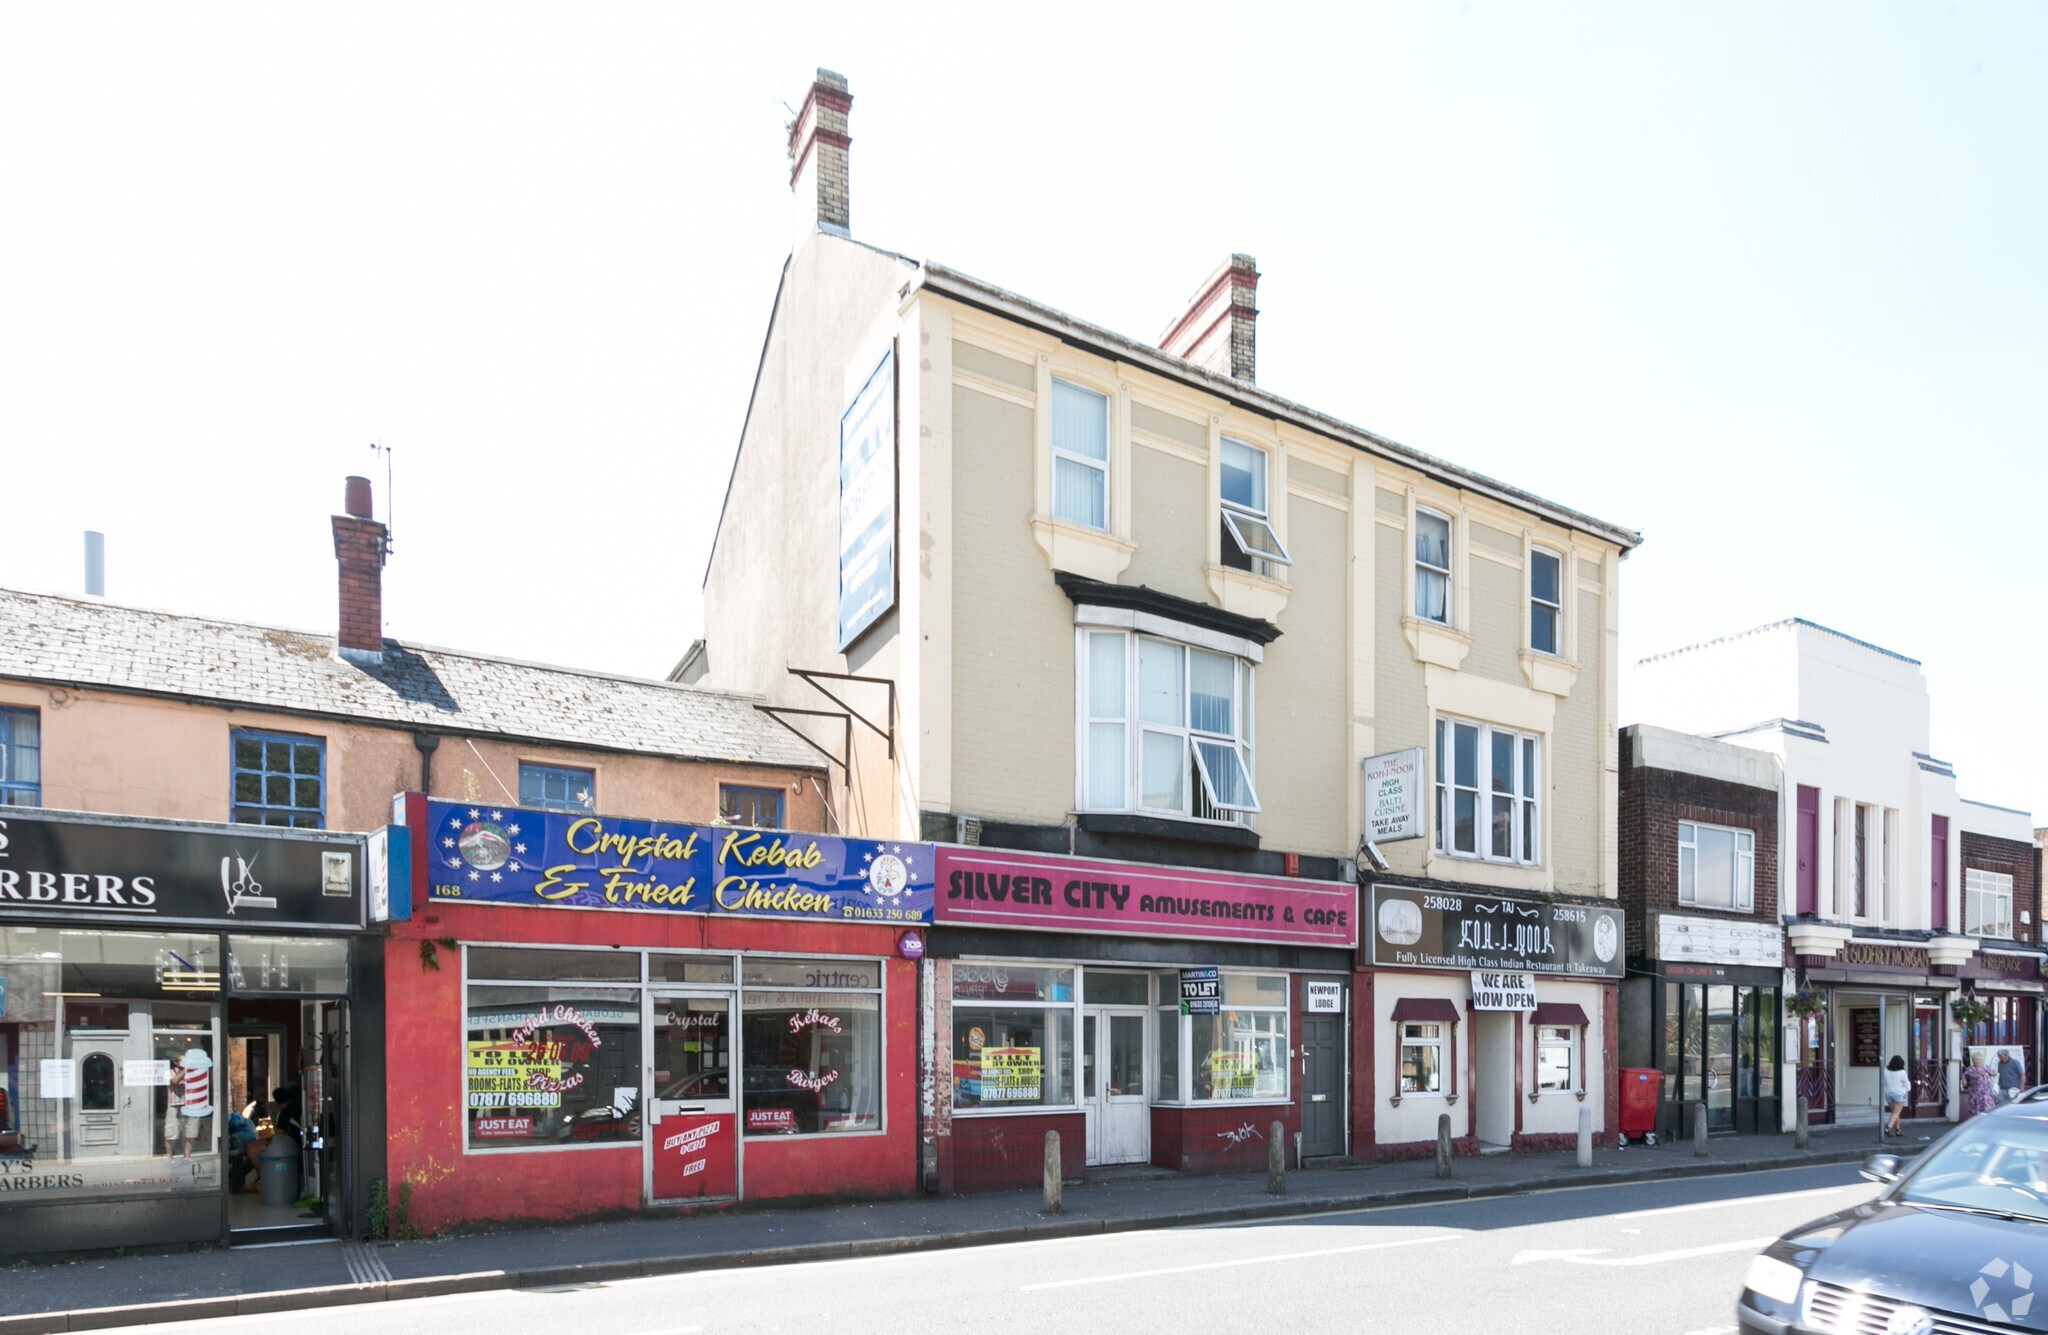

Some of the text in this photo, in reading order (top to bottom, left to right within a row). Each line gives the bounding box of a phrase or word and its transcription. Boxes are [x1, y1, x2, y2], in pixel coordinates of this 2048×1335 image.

[1383, 759, 1398, 768] THE
[1367, 763, 1414, 780] KOH-I-NOOR
[1381, 778, 1399, 787] HIGH
[1378, 786, 1403, 797] CLASS
[1380, 796, 1402, 807] BALTI
[1374, 804, 1406, 817] CUISINE
[1371, 814, 1409, 828] TAKE AWAY
[1377, 824, 1403, 835] MEALS
[566, 817, 824, 869] Crystal Kebab
[435, 885, 461, 896] 168
[534, 864, 590, 900] &
[600, 867, 695, 905] Fried
[715, 875, 834, 913] Chicken
[947, 869, 1347, 927] SILVER CITY AMUSEMENTS & CAFE
[854, 907, 923, 920] 01633 250 689
[1423, 895, 1586, 923] 258028 258615
[1502, 902, 1514, 914] TAJ
[904, 940, 922, 949] TOP
[1396, 951, 1418, 965] Fully
[1420, 952, 1455, 965] Licensed
[1458, 955, 1476, 968] High
[1479, 956, 1498, 967] Class
[1500, 957, 1524, 969] Indian
[1526, 959, 1564, 972] Restaurant
[1574, 963, 1607, 975] Takeaway
[1850, 944, 1891, 965] GODFREY
[1892, 948, 1929, 968] MORGAN
[1481, 973, 1525, 989] WE ARE
[1183, 982, 1217, 997] TO LET
[1310, 986, 1339, 996] NEWPORT
[1315, 999, 1334, 1008] LODGE
[1474, 991, 1535, 1008] NOW OPEN
[512, 1004, 602, 1048] Fried Chicken
[665, 1011, 720, 1031] Crystal
[789, 1008, 842, 1034] Kebabs
[508, 1058, 560, 1066] OWNER
[468, 1068, 476, 1076] NO
[478, 1068, 500, 1076] AGENCY
[526, 1068, 551, 1077] SHOP
[468, 1077, 521, 1091] ROOMS-FLATS
[526, 1072, 584, 1092] Pizzas
[786, 1069, 839, 1093] Burgers
[469, 1092, 558, 1107] 07877 696880
[983, 1087, 1038, 1099] 07877 696880
[750, 1111, 792, 1121] JUST EAT
[478, 1119, 530, 1130] JUST EAT
[665, 1122, 719, 1149] BUY ANY PIZZA
